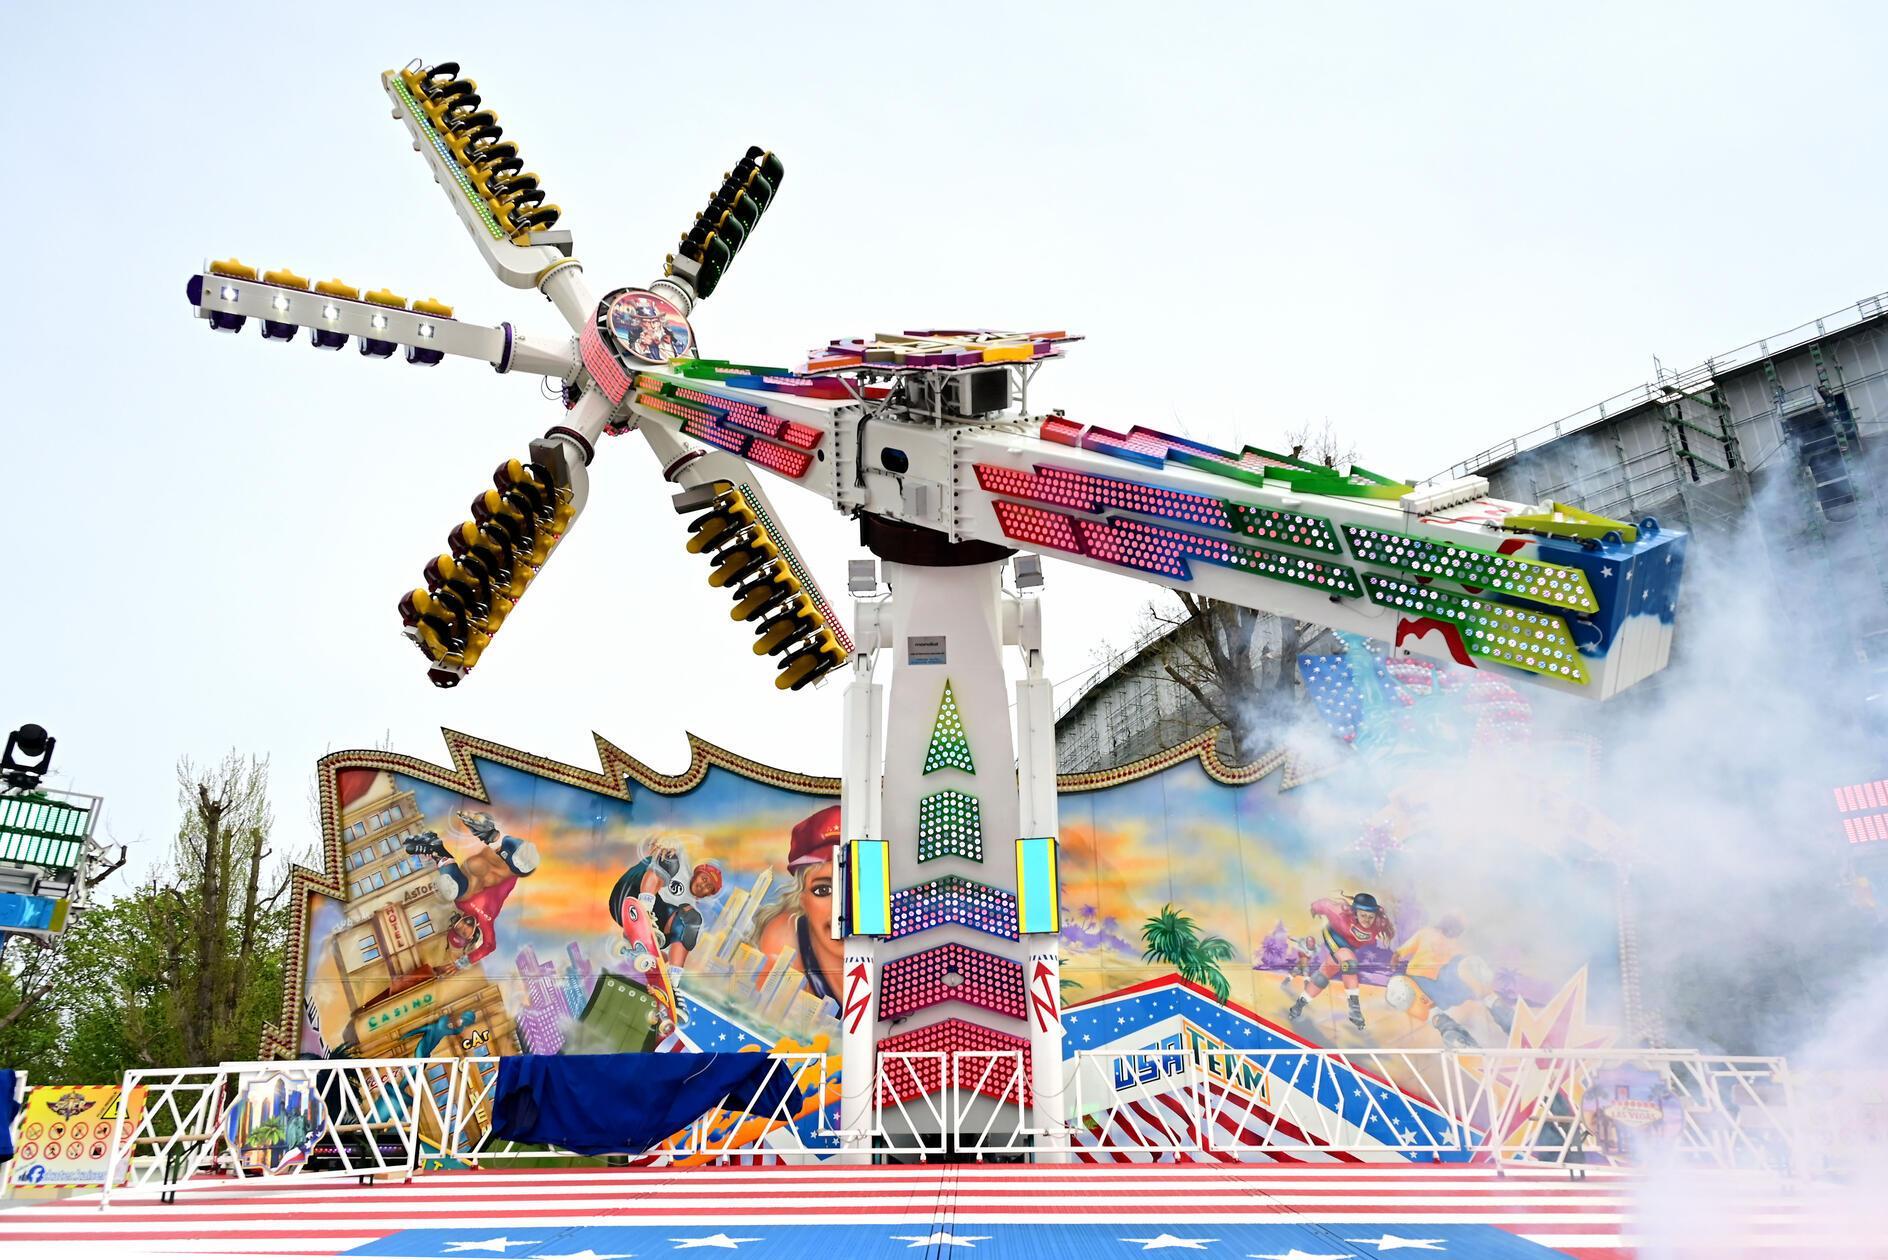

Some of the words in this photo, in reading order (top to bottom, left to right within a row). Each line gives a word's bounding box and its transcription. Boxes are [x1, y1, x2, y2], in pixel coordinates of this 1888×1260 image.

[384, 906, 404, 948] HOTEL
[368, 994, 433, 1028] CASINO
[1113, 1032, 1184, 1091] USA
[1184, 1021, 1269, 1104] TEAM
